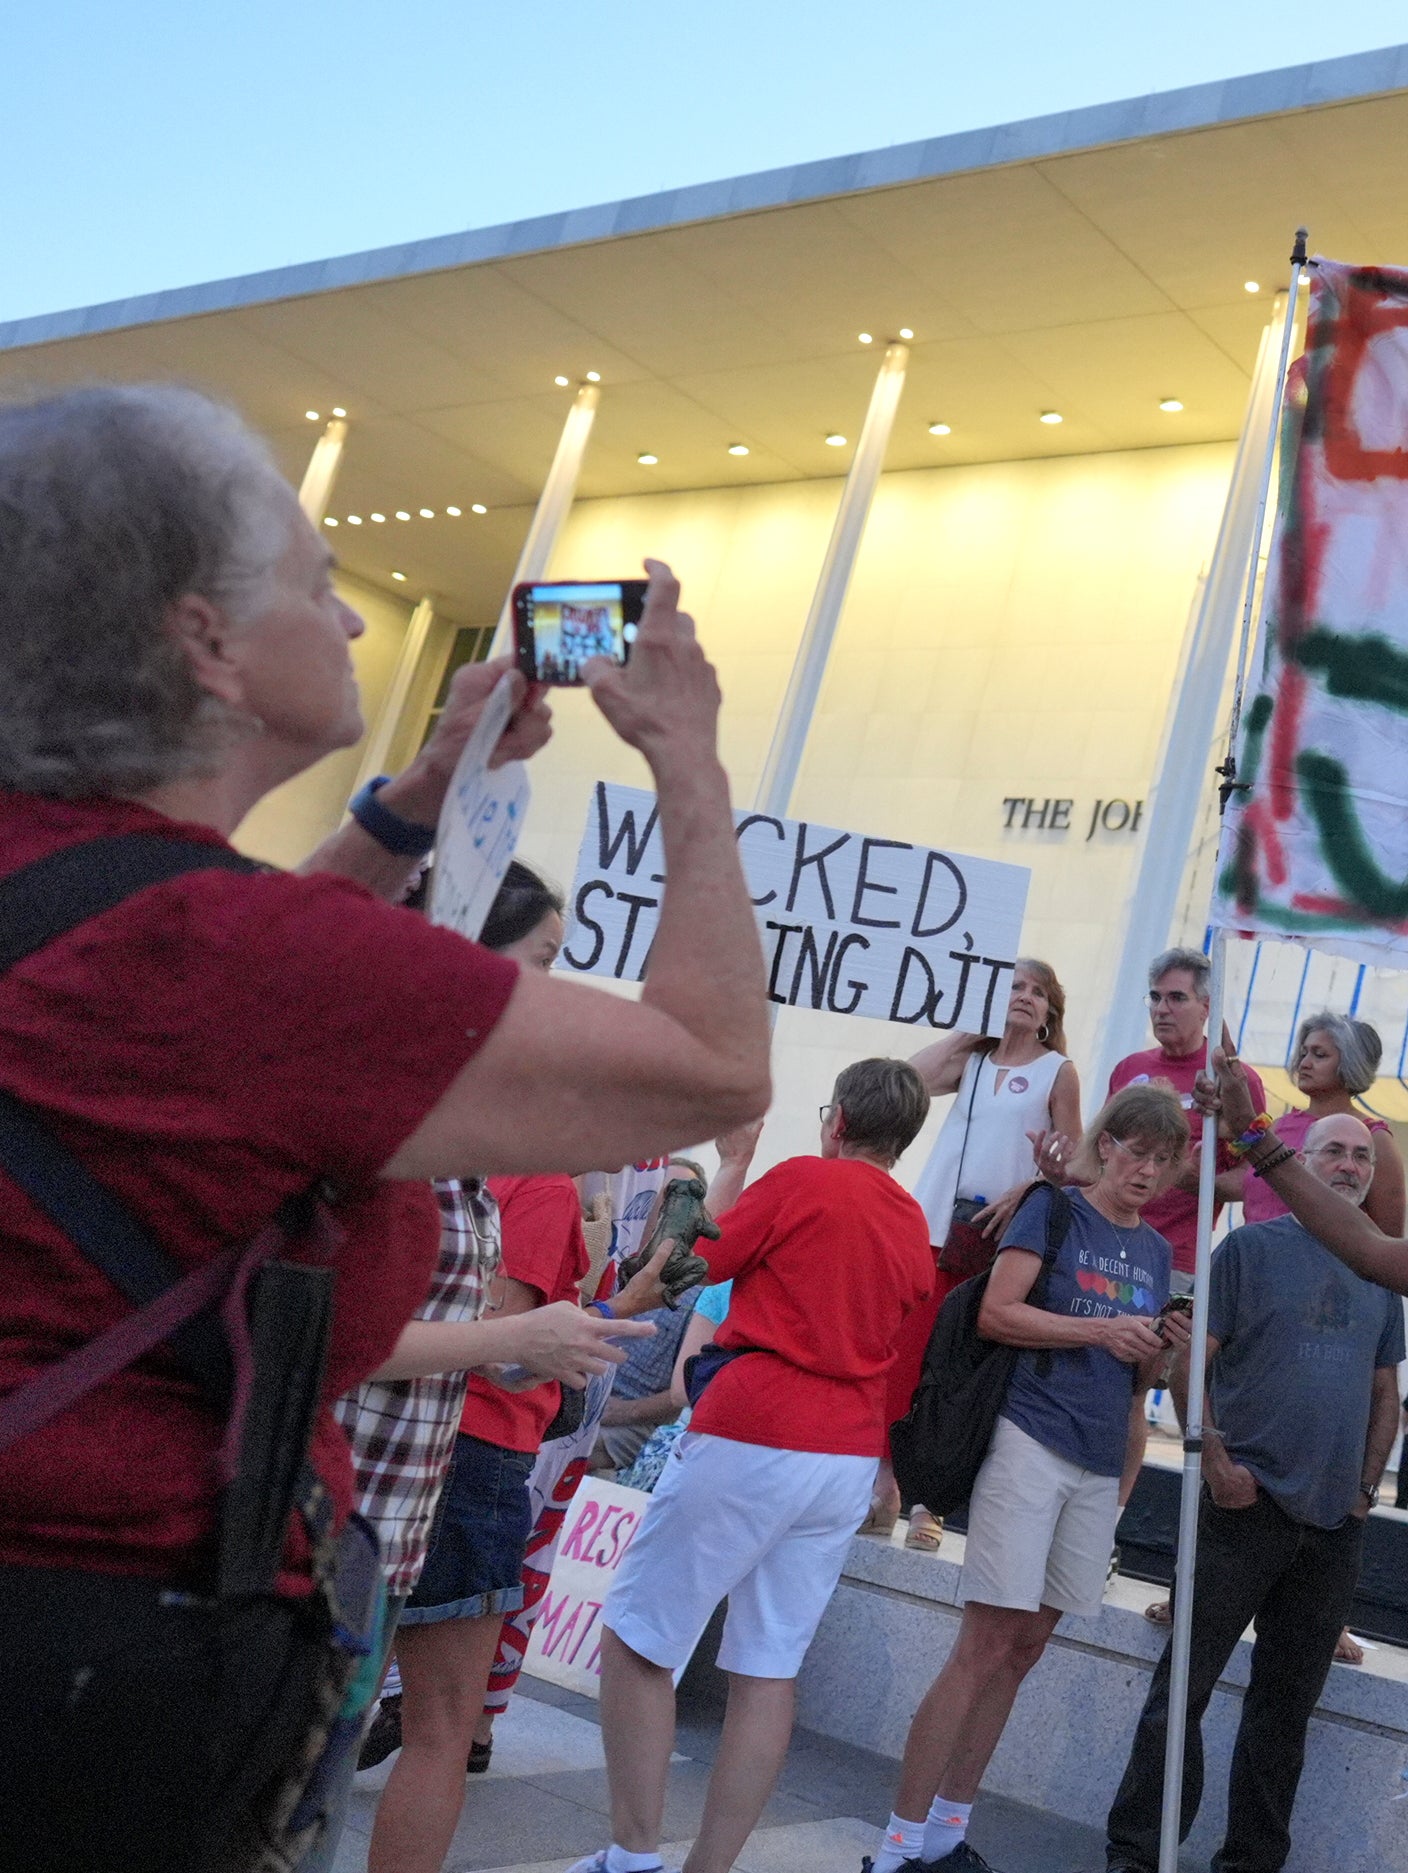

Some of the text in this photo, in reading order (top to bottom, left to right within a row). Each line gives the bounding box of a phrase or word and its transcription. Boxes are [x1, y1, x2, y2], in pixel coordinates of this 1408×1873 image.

[1003, 797, 1074, 829] THE
[596, 779, 974, 952] WCKED,
[562, 879, 1016, 1036] STING DJT
[1078, 1249, 1091, 1266] BE
[1099, 1256, 1130, 1278] DECENT
[1070, 1297, 1093, 1315] IT'S
